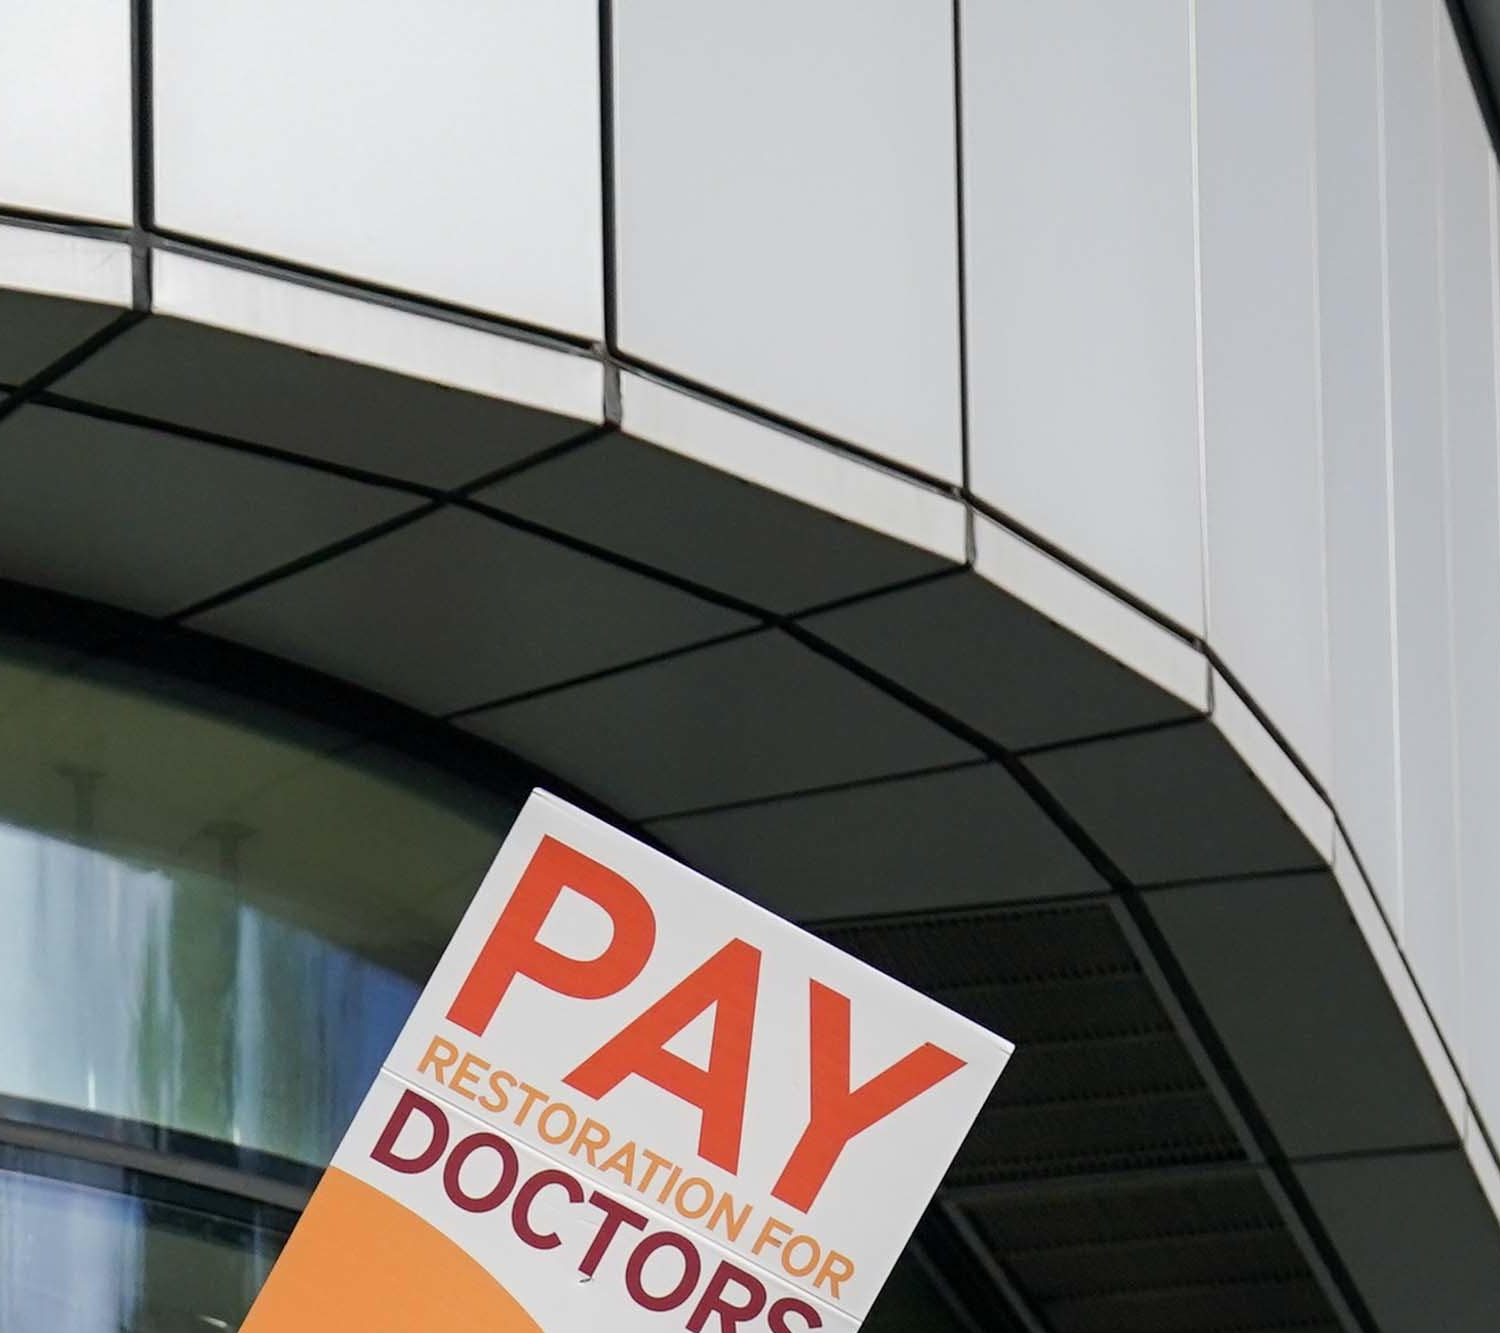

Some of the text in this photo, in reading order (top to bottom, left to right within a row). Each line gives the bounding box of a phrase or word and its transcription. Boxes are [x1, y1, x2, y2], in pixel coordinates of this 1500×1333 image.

[417, 1035, 855, 1300] RESTORATION FOR
[445, 834, 967, 1215] PAY
